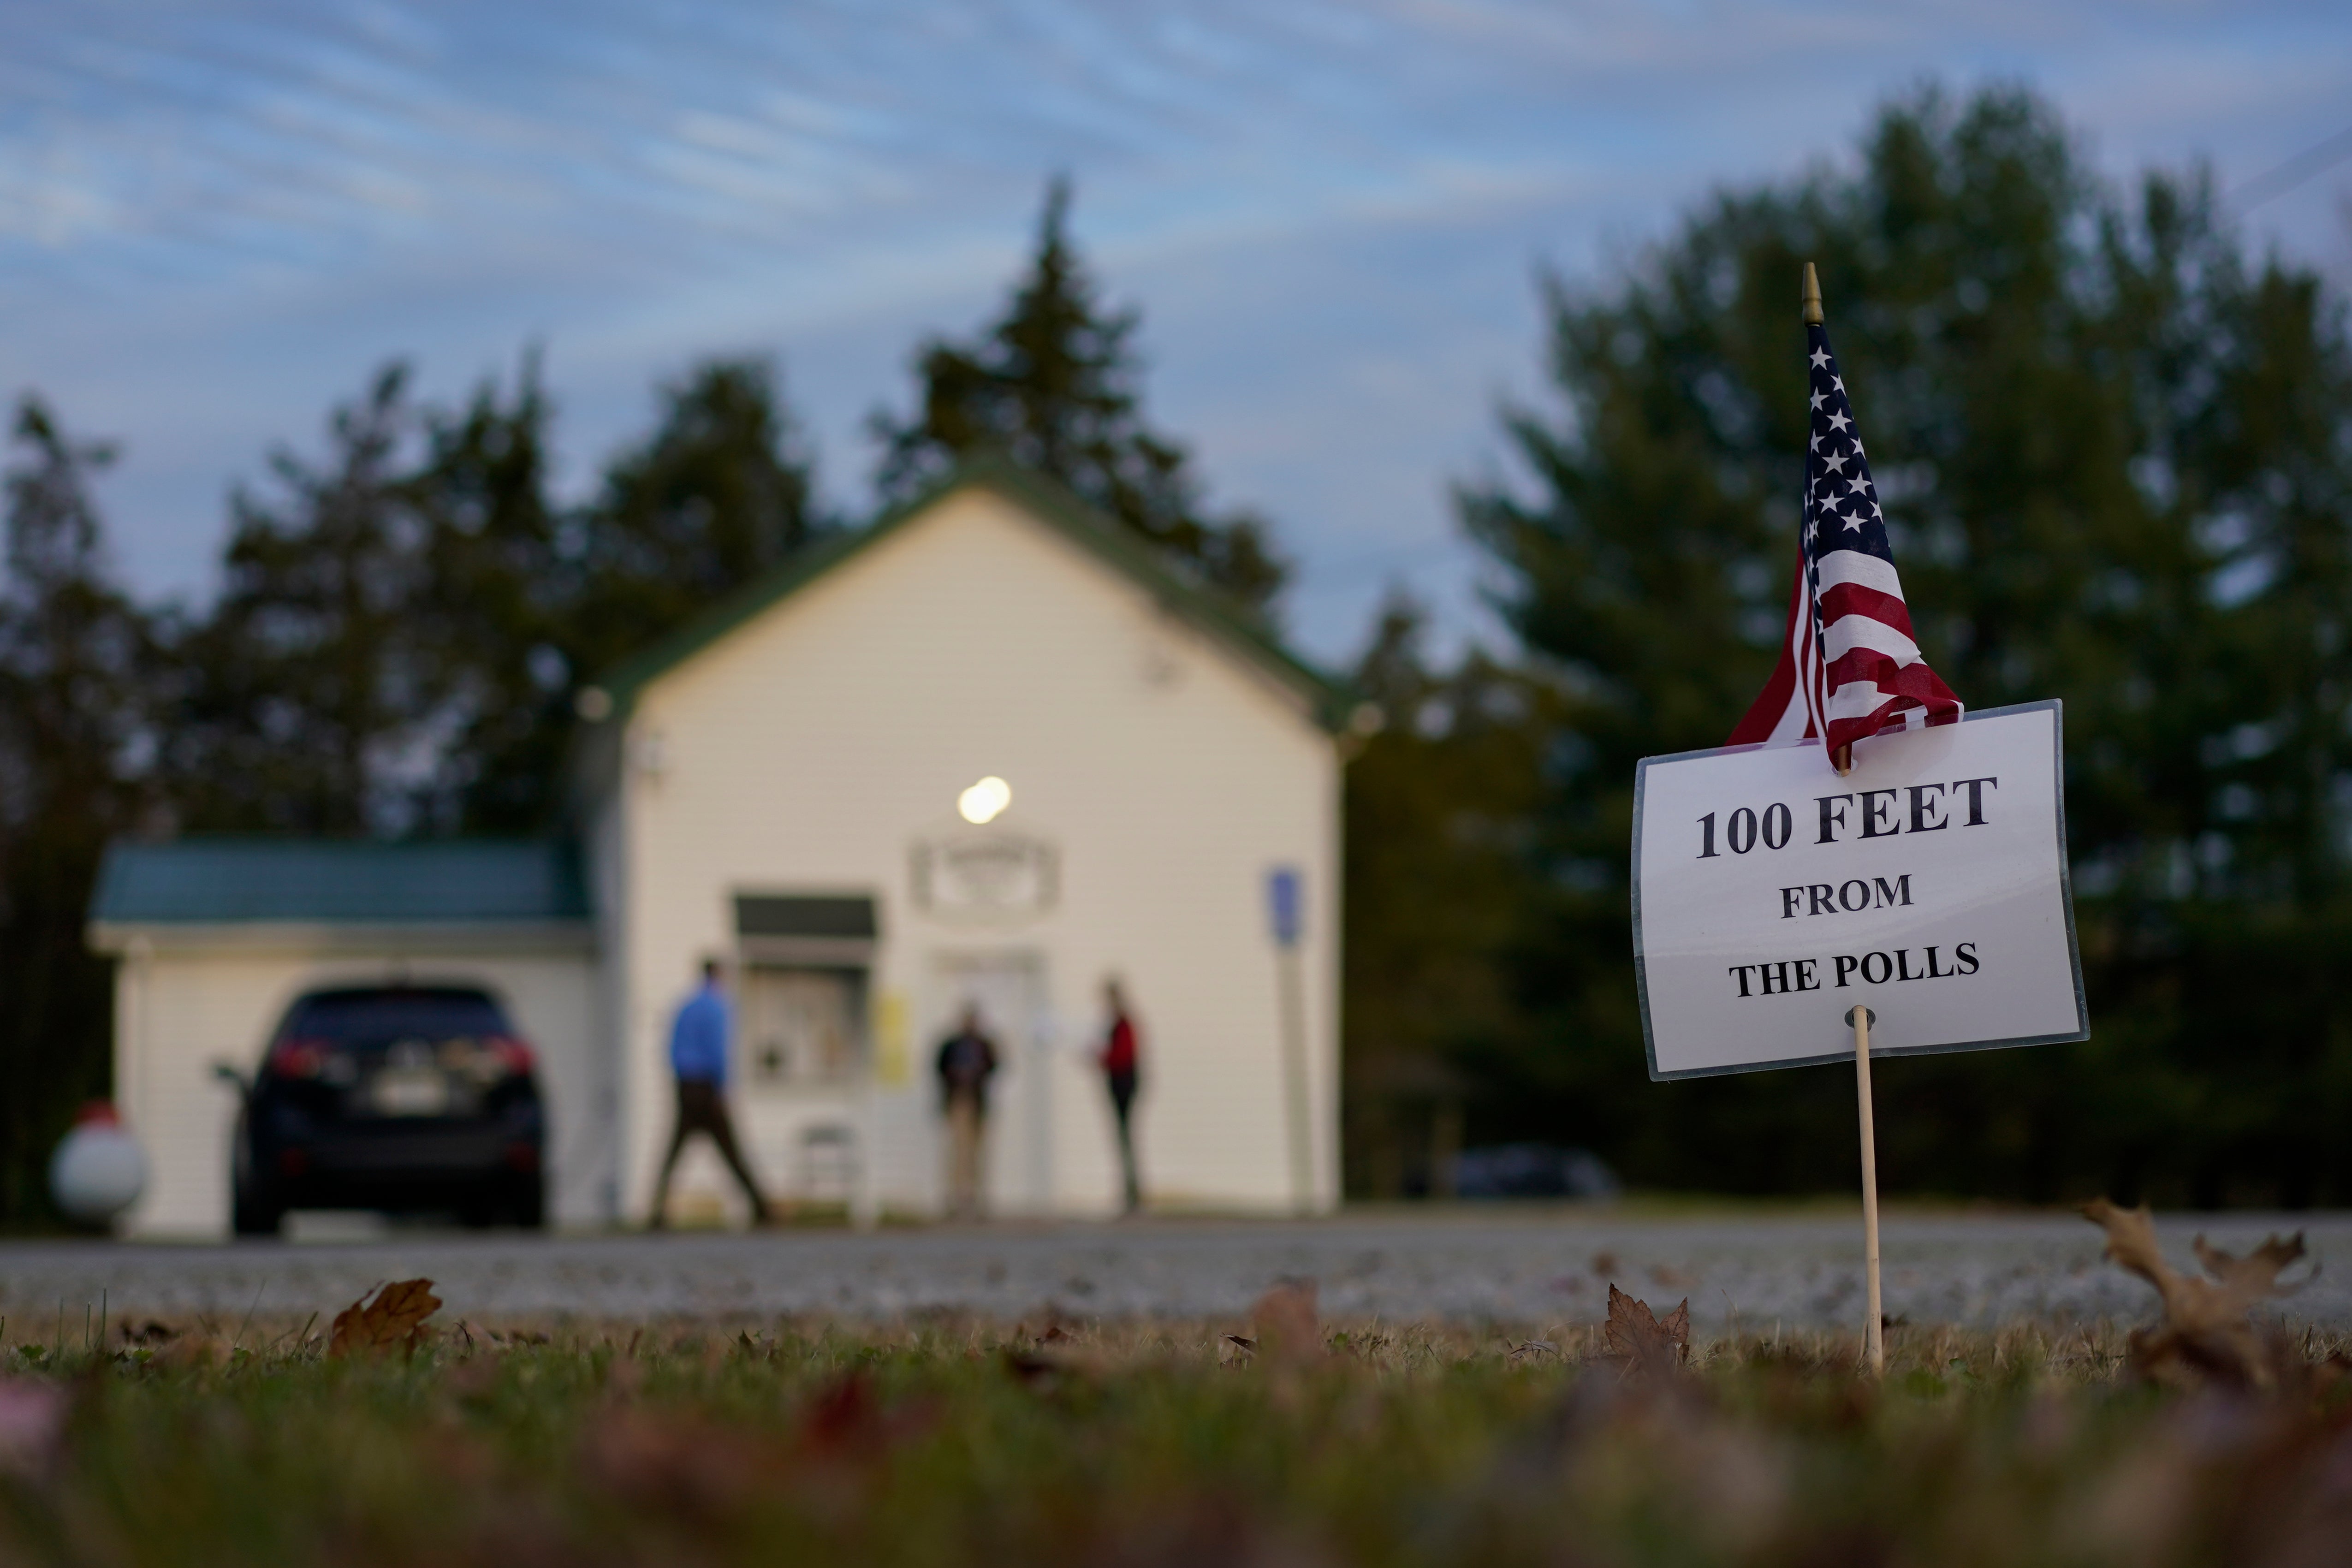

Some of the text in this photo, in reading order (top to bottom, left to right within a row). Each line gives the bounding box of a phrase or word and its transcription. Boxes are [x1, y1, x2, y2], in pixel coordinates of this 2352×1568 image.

[1696, 777, 1998, 859] 100 FEET
[1779, 874, 1914, 919] FROM
[1728, 942, 1980, 998] THE POLLS
